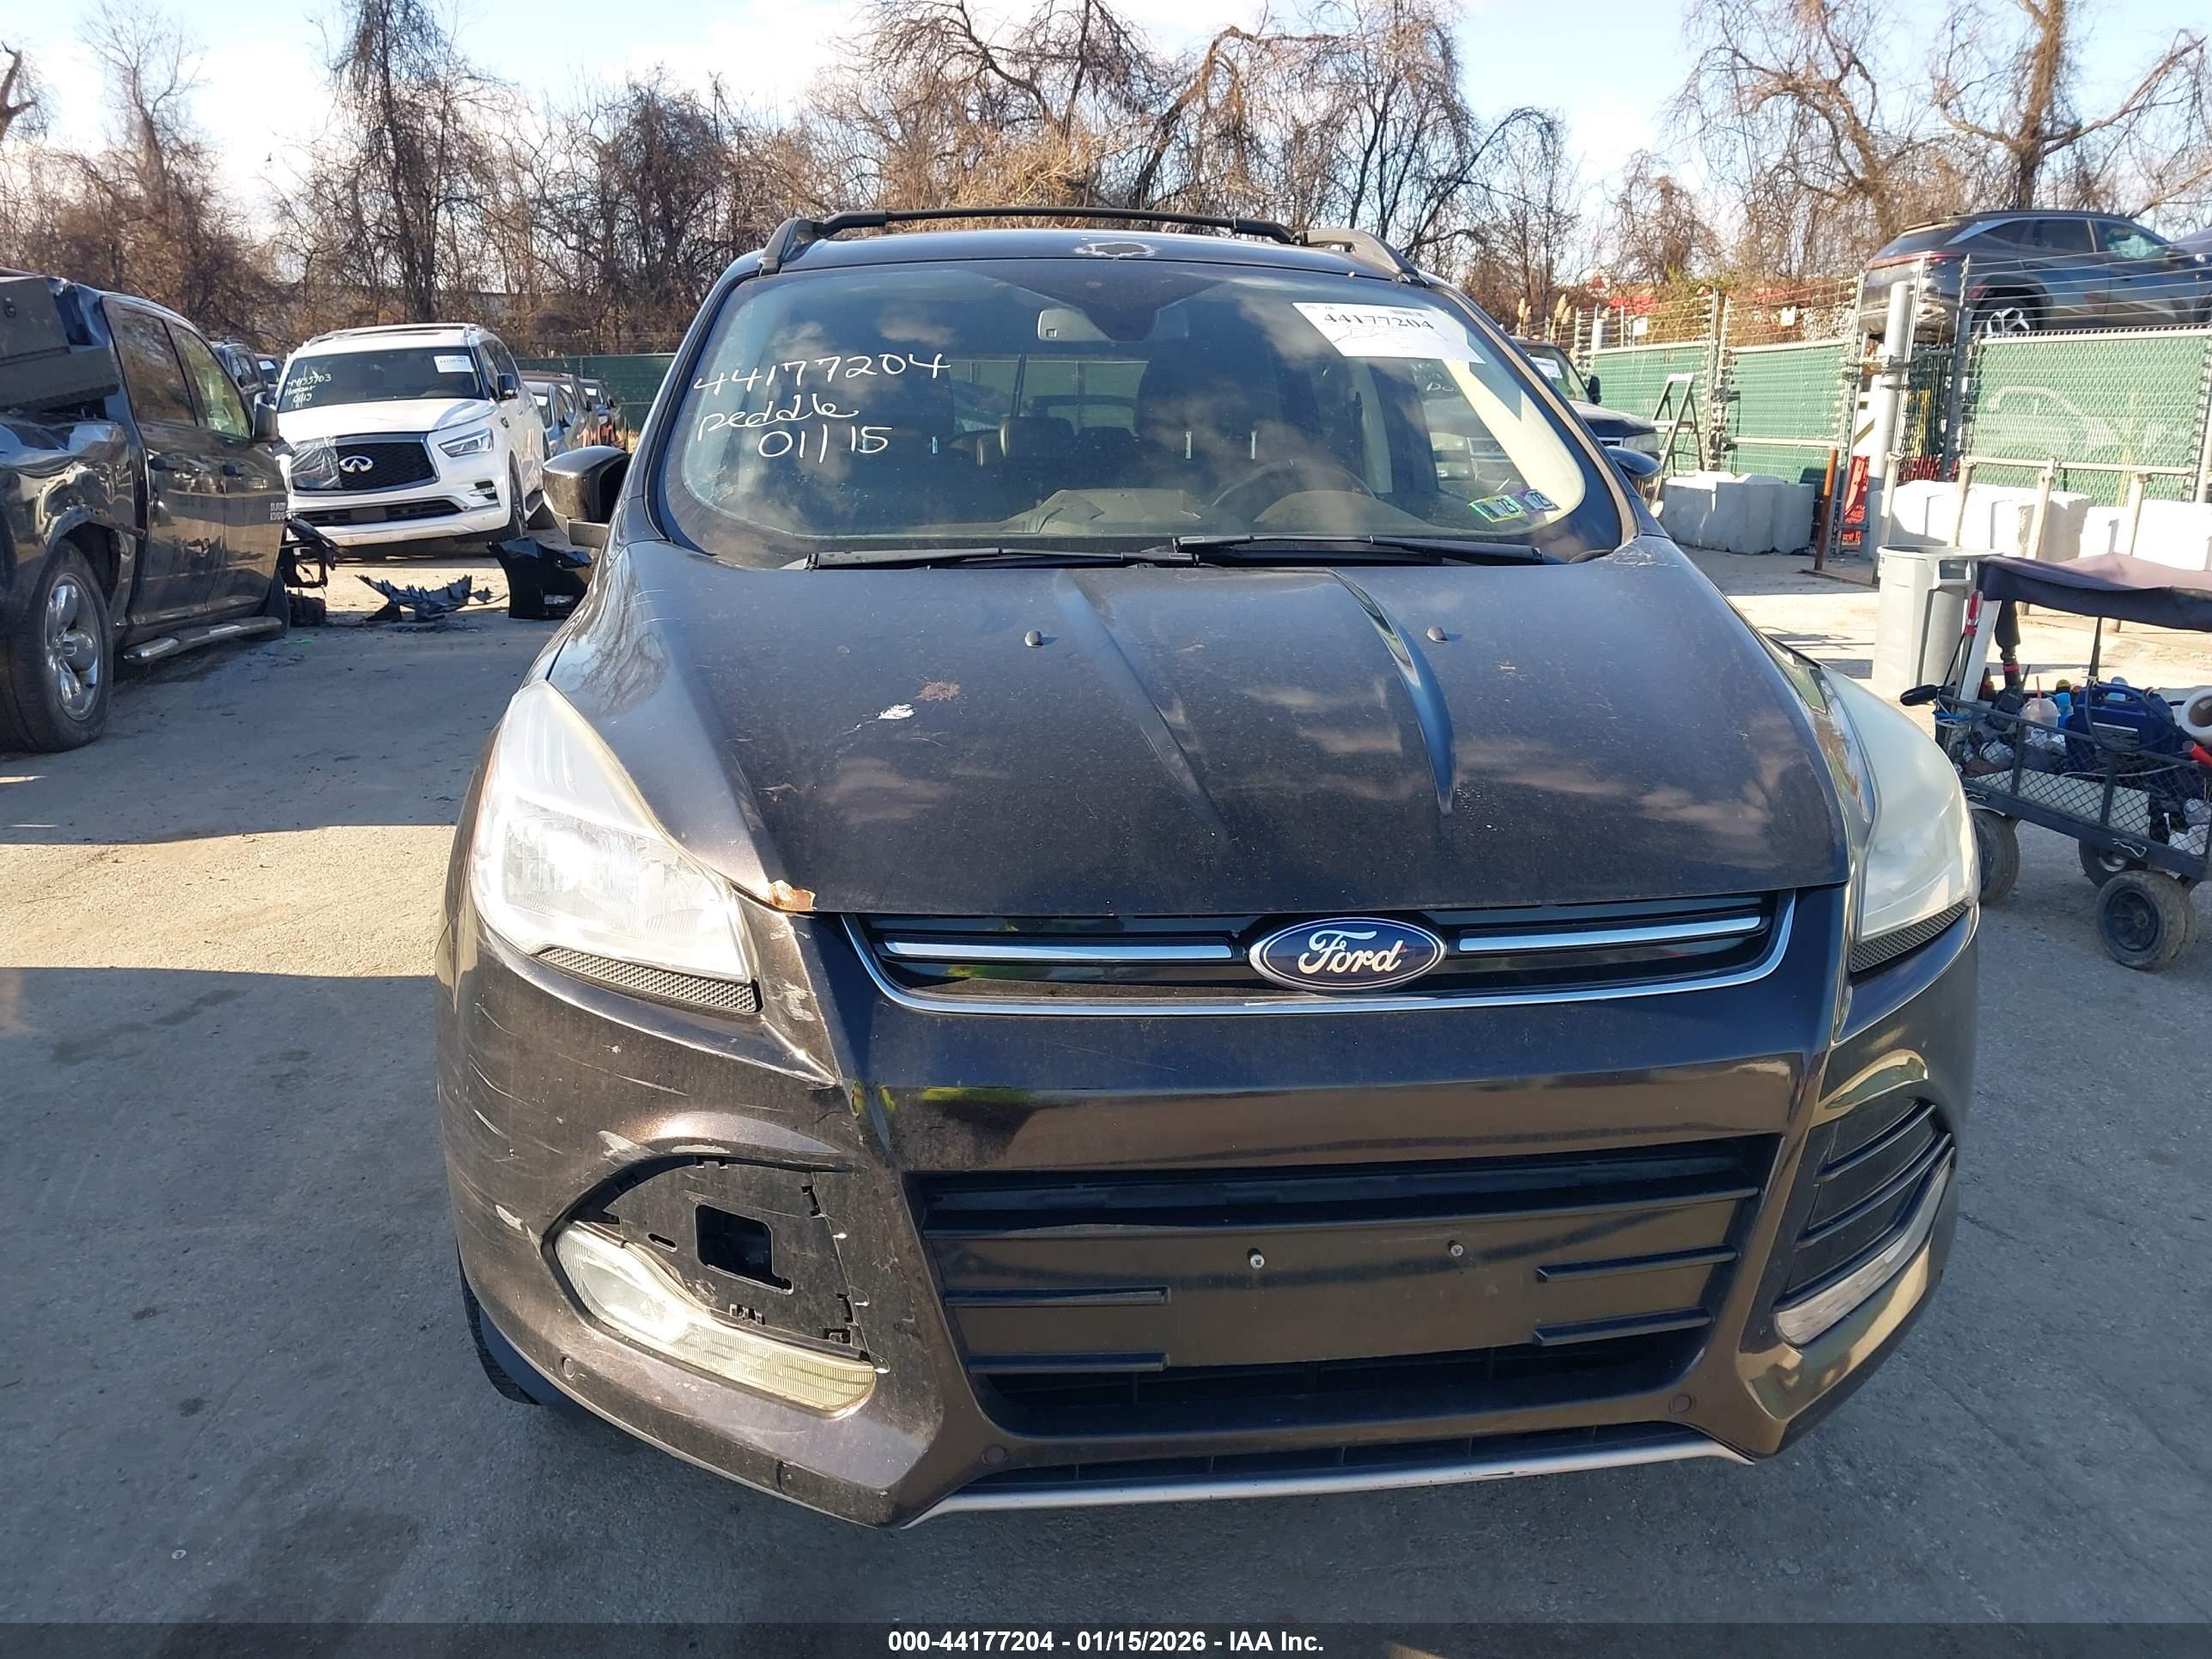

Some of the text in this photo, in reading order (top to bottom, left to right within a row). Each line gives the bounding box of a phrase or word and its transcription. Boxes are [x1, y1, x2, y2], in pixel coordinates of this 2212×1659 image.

[1324, 309, 1435, 330] 44177204
[694, 353, 951, 393] 44177204
[757, 423, 893, 464] 01/15
[1297, 929, 1405, 975] Ford
